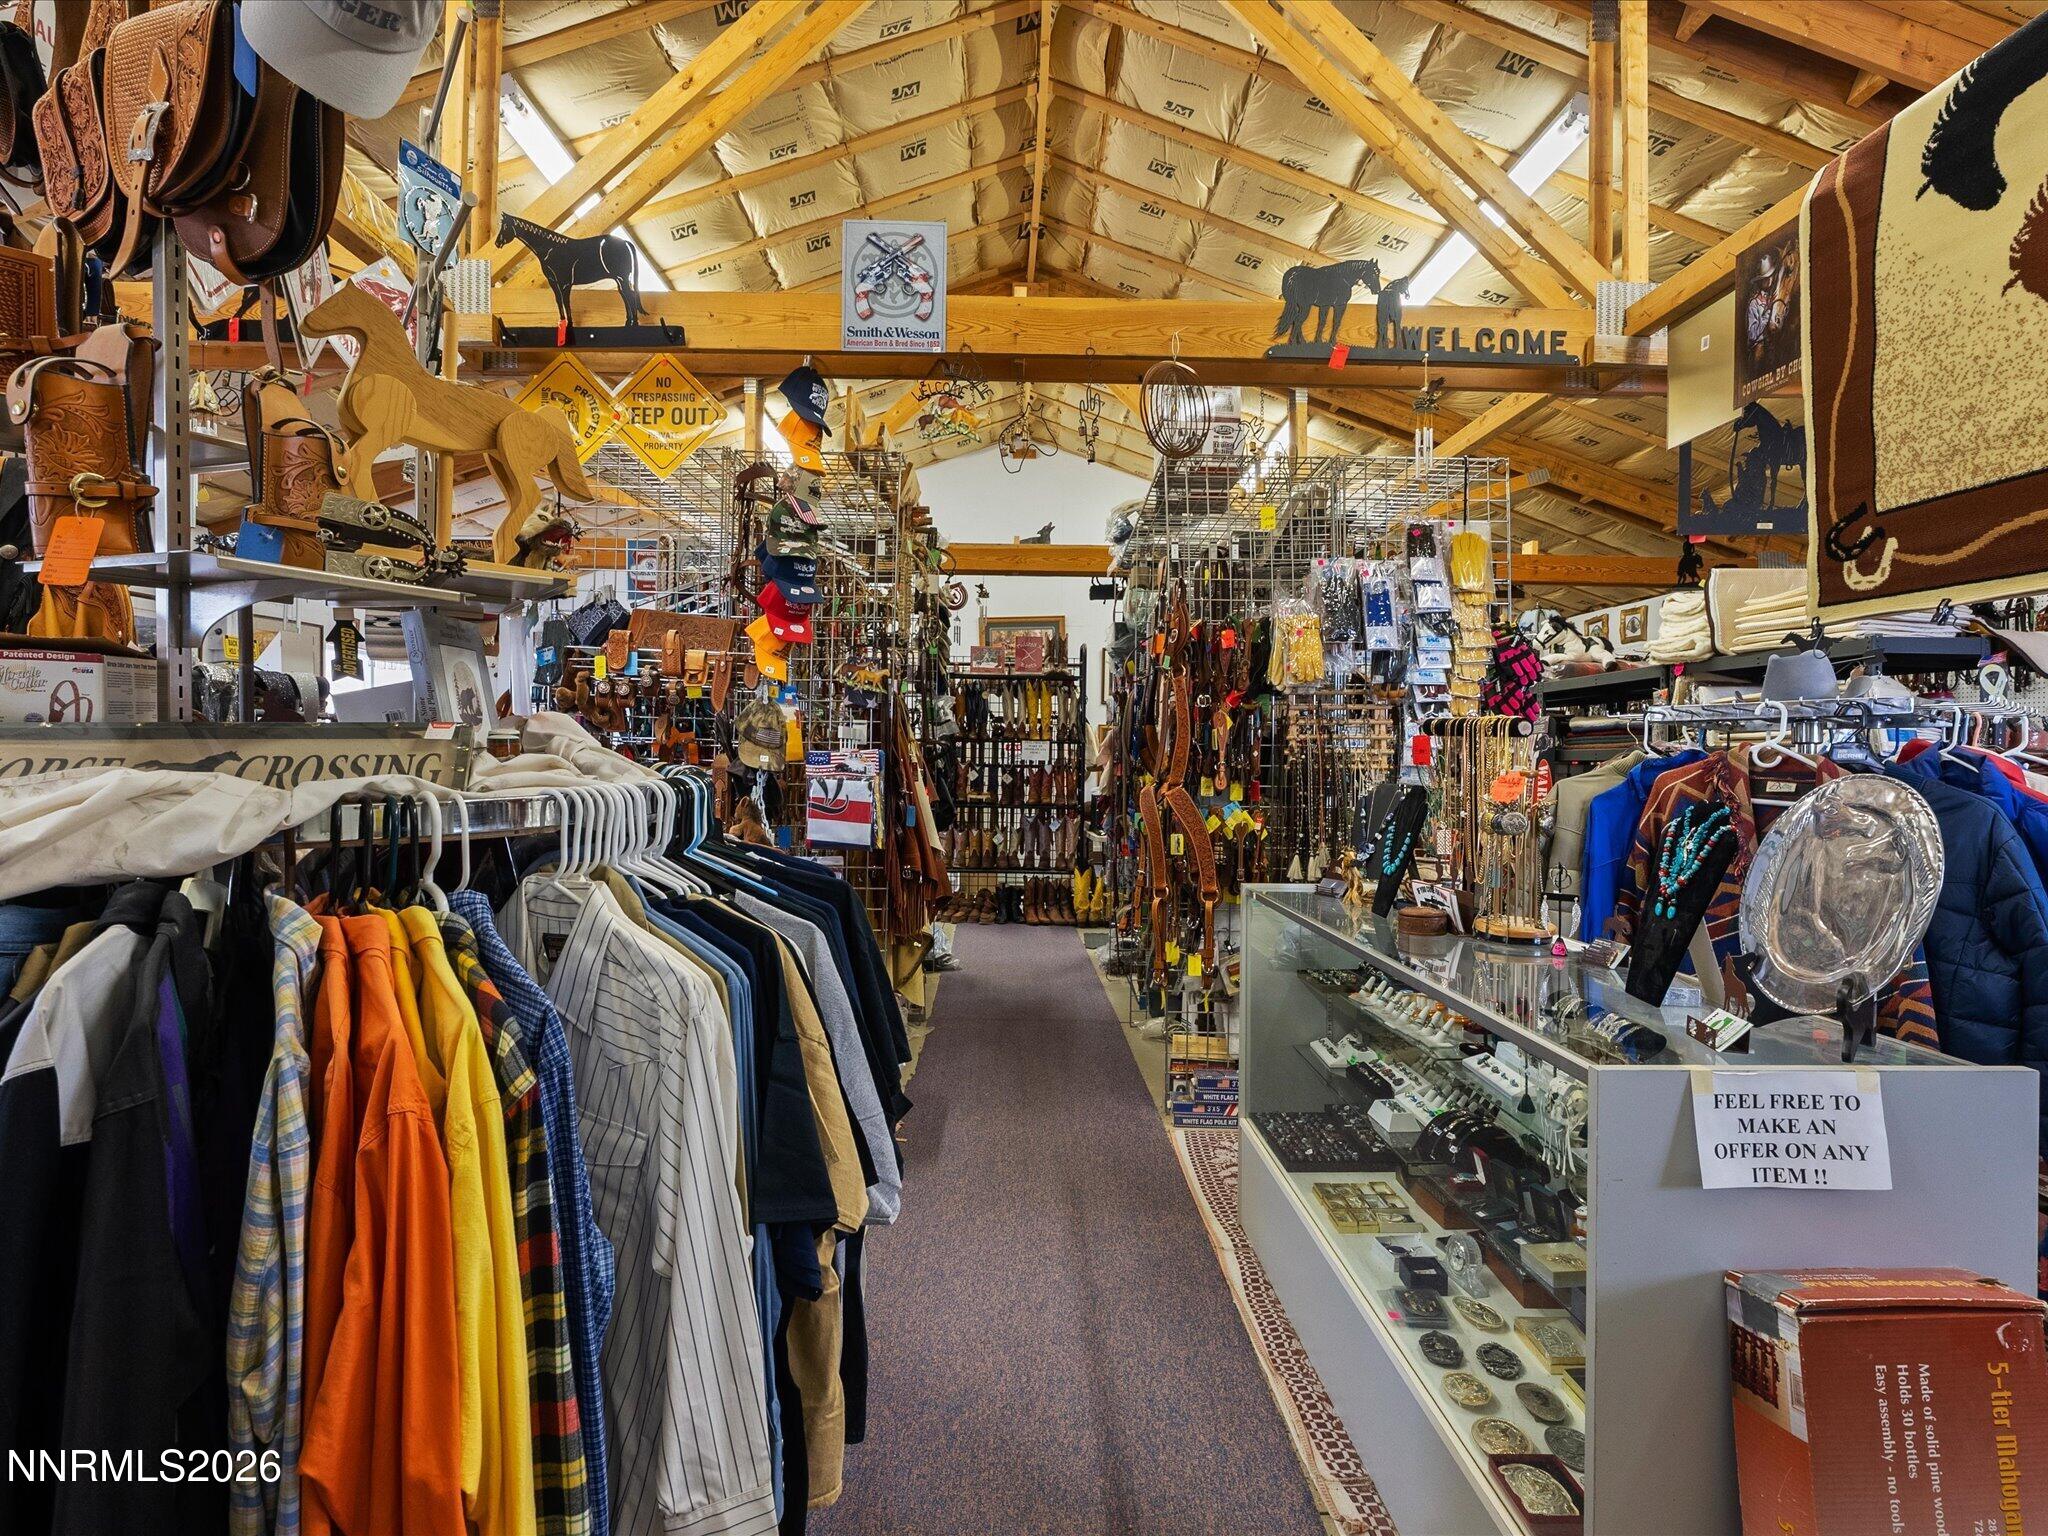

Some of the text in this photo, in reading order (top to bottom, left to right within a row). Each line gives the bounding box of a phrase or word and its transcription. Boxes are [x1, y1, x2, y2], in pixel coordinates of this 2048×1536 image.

[847, 339, 873, 347] American
[895, 340, 908, 348] Bred
[909, 340, 926, 348] Since
[1402, 326, 1568, 355] WELCOME
[655, 376, 672, 388] NO
[1742, 371, 1774, 397] COWGIRL
[631, 391, 696, 403] TRESPASSING
[573, 384, 600, 439] PROTECTED
[671, 407, 709, 425] OUT
[643, 442, 683, 451] PROPERTY
[3, 651, 44, 659] Patented
[340, 627, 358, 677] ADVERTISED
[234, 753, 442, 790] CROSSING
[1713, 1093, 1861, 1112] FEEL FREE TO
[1182, 1118, 1199, 1126] WHITE
[1737, 1118, 1837, 1135] MAKE AN
[1714, 1142, 1869, 1162] OFFER ON ANY
[1752, 1167, 1828, 1185] ITEM !!
[1873, 1364, 1888, 1395] Easy
[1987, 1362, 2015, 1429] 5-tier
[1878, 1398, 1897, 1462] assembly
[1896, 1364, 1920, 1480] Holds 30 bottles
[1918, 1363, 1950, 1536] Made of solid pine wood
[1887, 1476, 1898, 1495] no
[1889, 1499, 1906, 1534] tools
